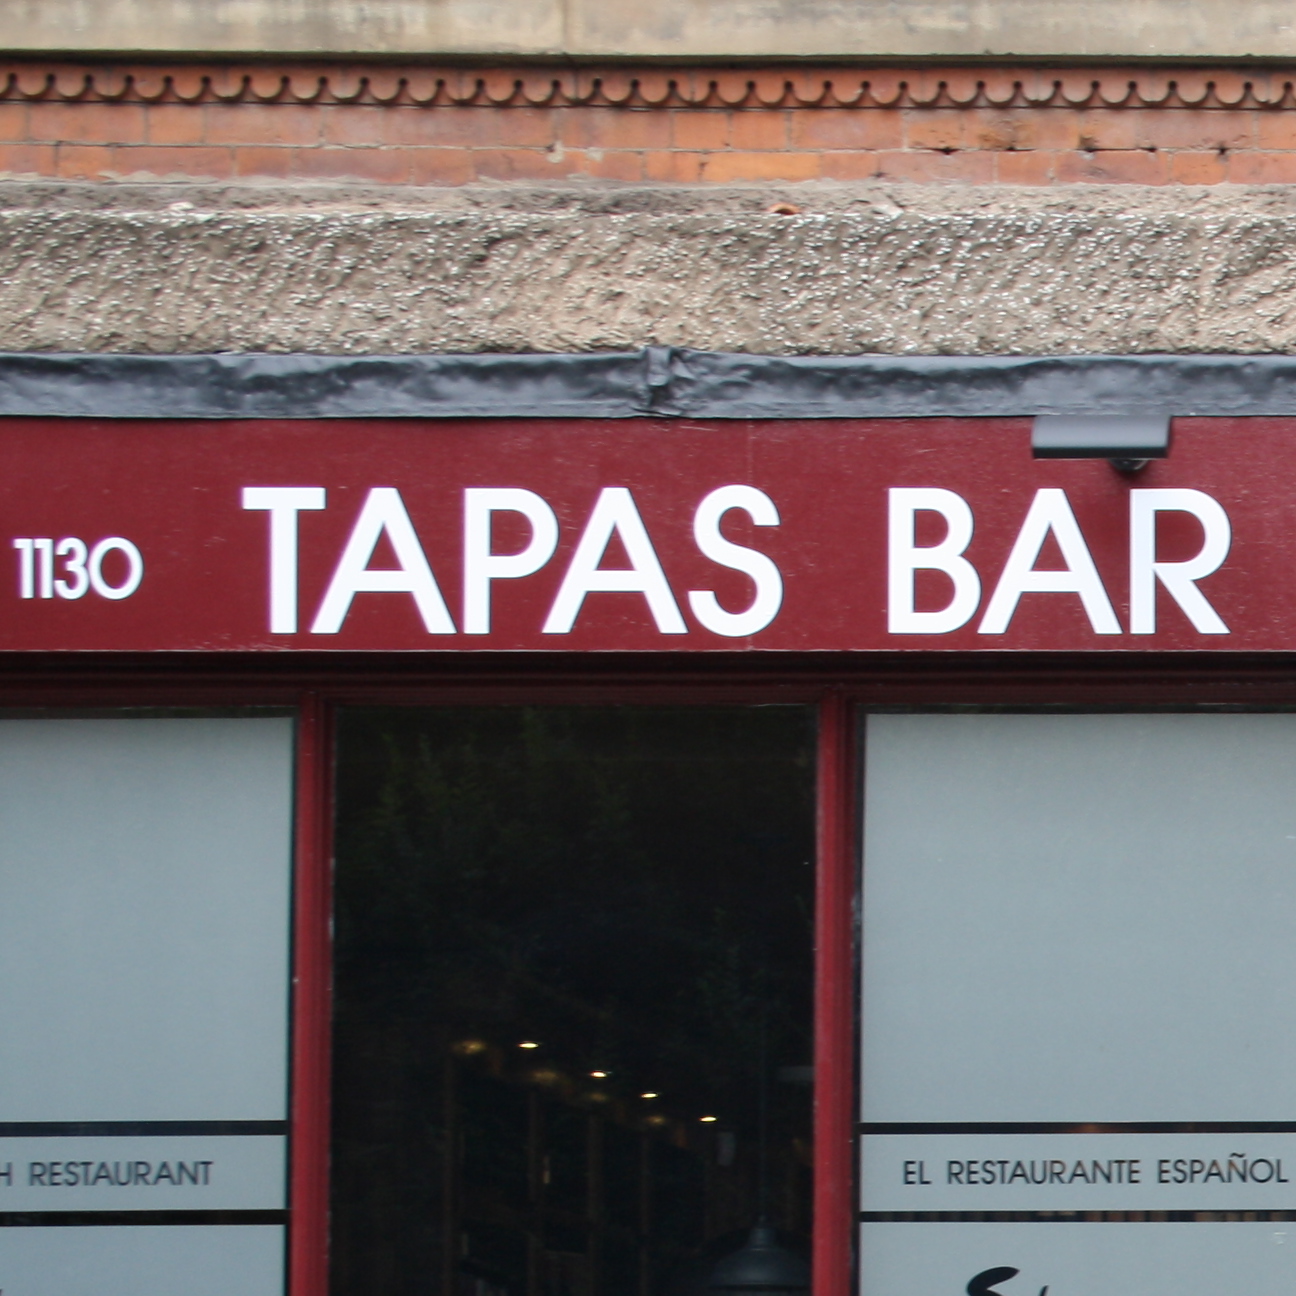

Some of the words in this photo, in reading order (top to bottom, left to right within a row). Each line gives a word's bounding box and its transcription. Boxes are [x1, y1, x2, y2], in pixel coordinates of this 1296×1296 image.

[14, 537, 143, 599] 1130
[242, 485, 783, 637] TAPAS
[888, 487, 1231, 634] BAR
[29, 1161, 214, 1186] RESTAURANT
[903, 1160, 932, 1185] EL
[947, 1159, 1141, 1184] RESTAURANTE
[1157, 1153, 1289, 1183] ESPAÑOL
